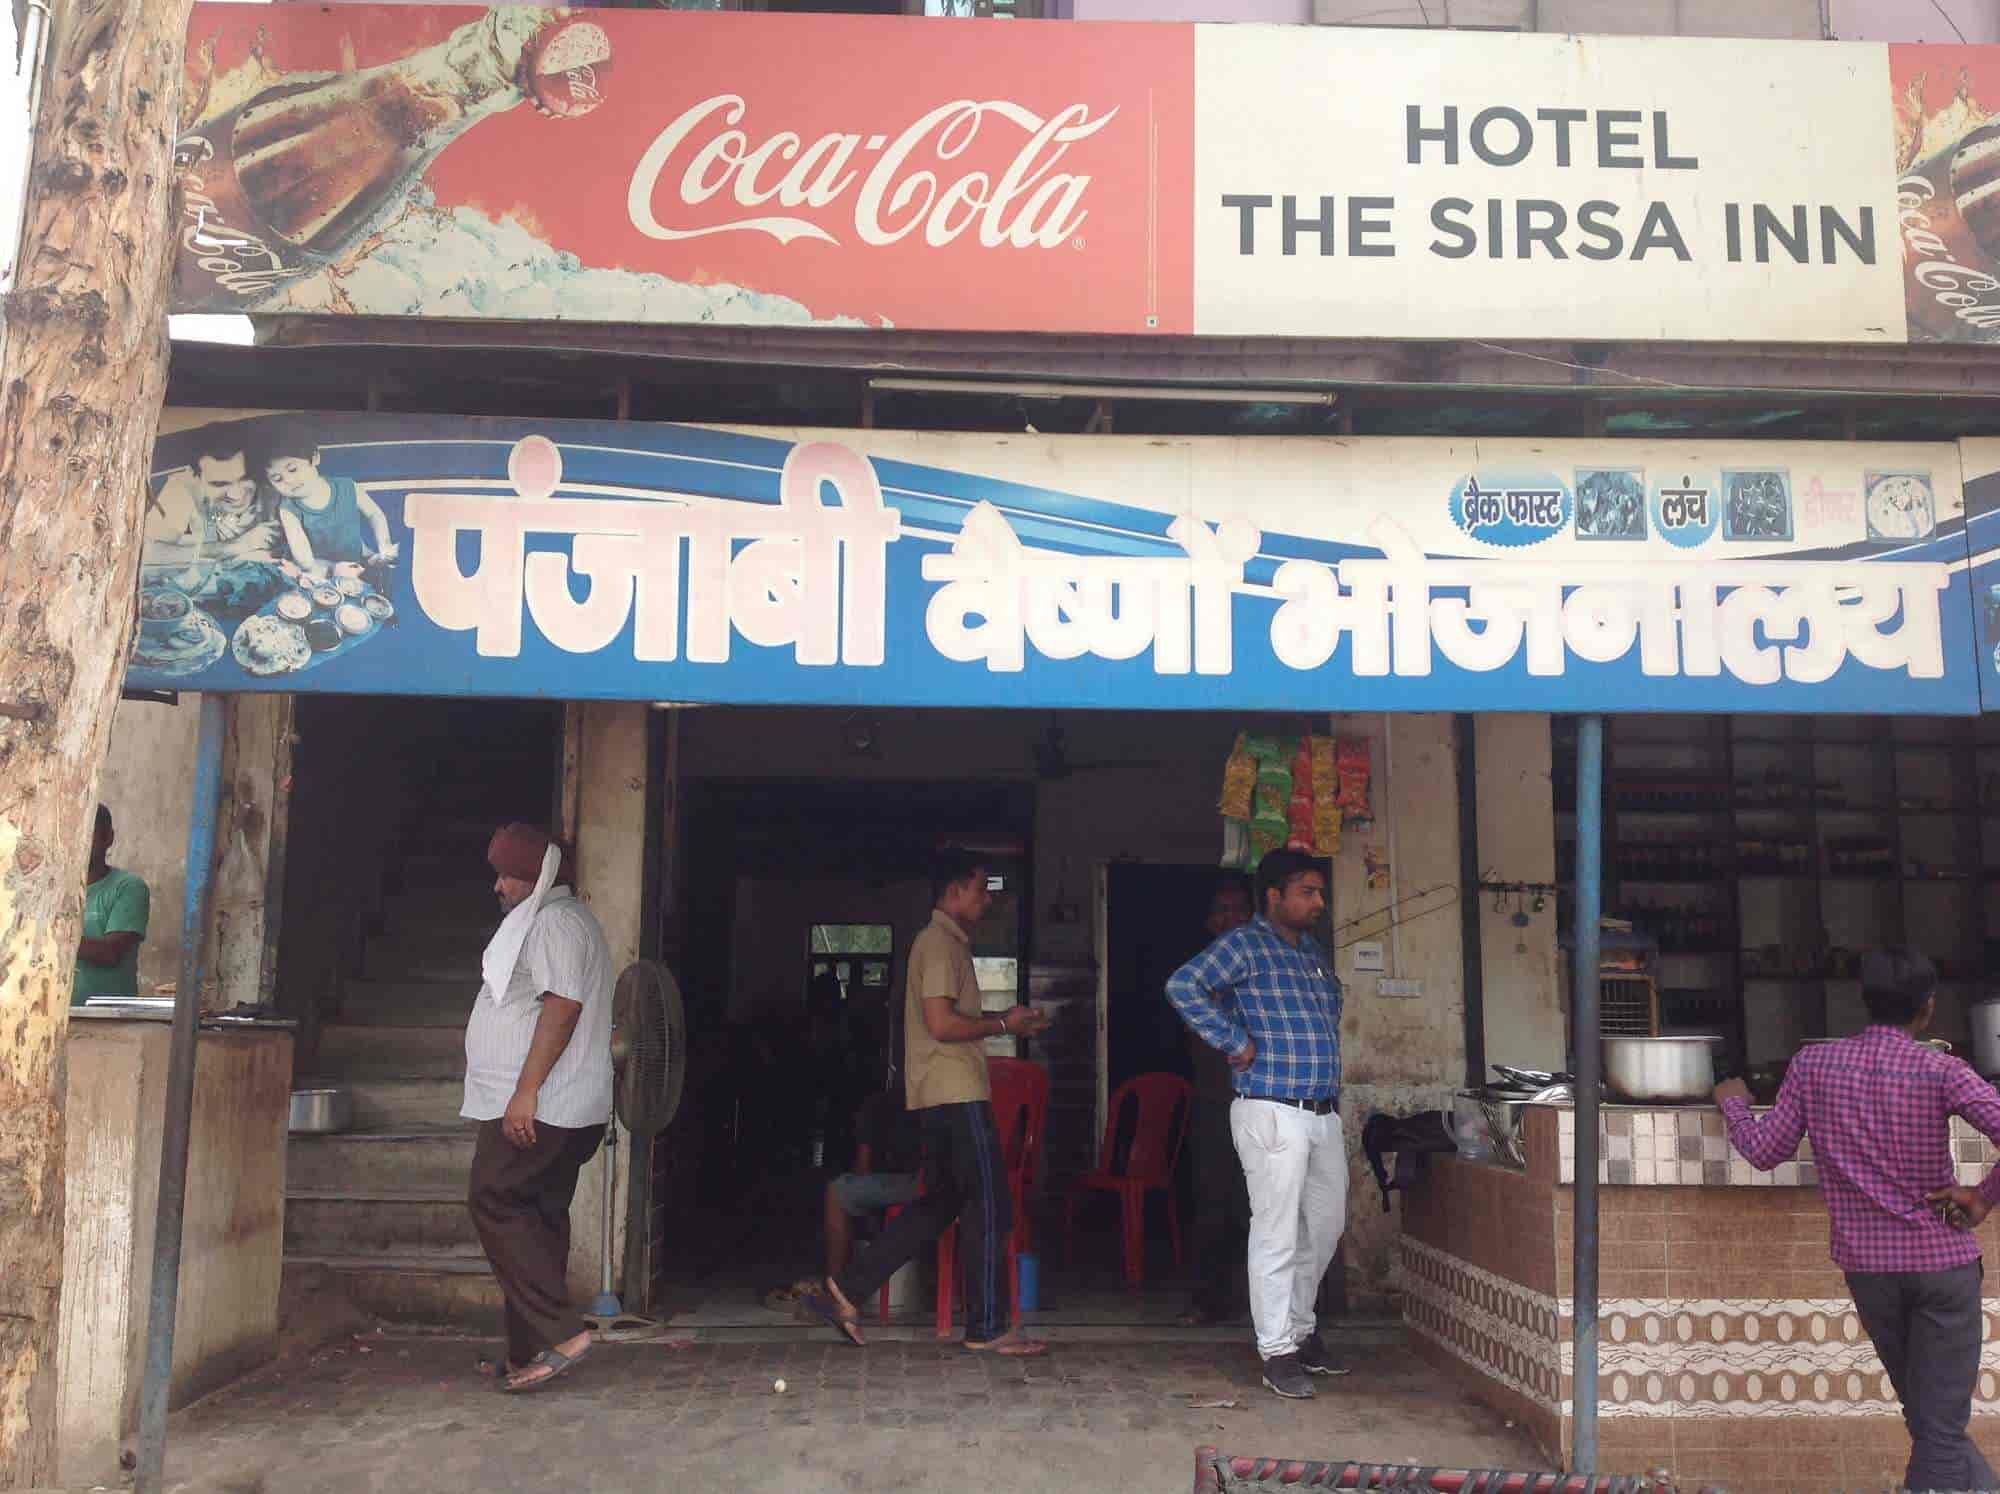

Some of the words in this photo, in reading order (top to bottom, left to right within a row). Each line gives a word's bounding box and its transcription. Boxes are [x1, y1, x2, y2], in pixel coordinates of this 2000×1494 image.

[628, 95, 1120, 247] Coca-Cola
[1406, 105, 1698, 170] HOTEL
[1221, 194, 1395, 257] THE
[1429, 197, 1692, 262] SIRSA
[1724, 203, 1877, 265] INN
[1507, 491, 1561, 524] फास्ट
[1660, 475, 1707, 525] लंच
[403, 435, 900, 666] पंजाबी
[1270, 513, 1951, 685] भोजनालय
